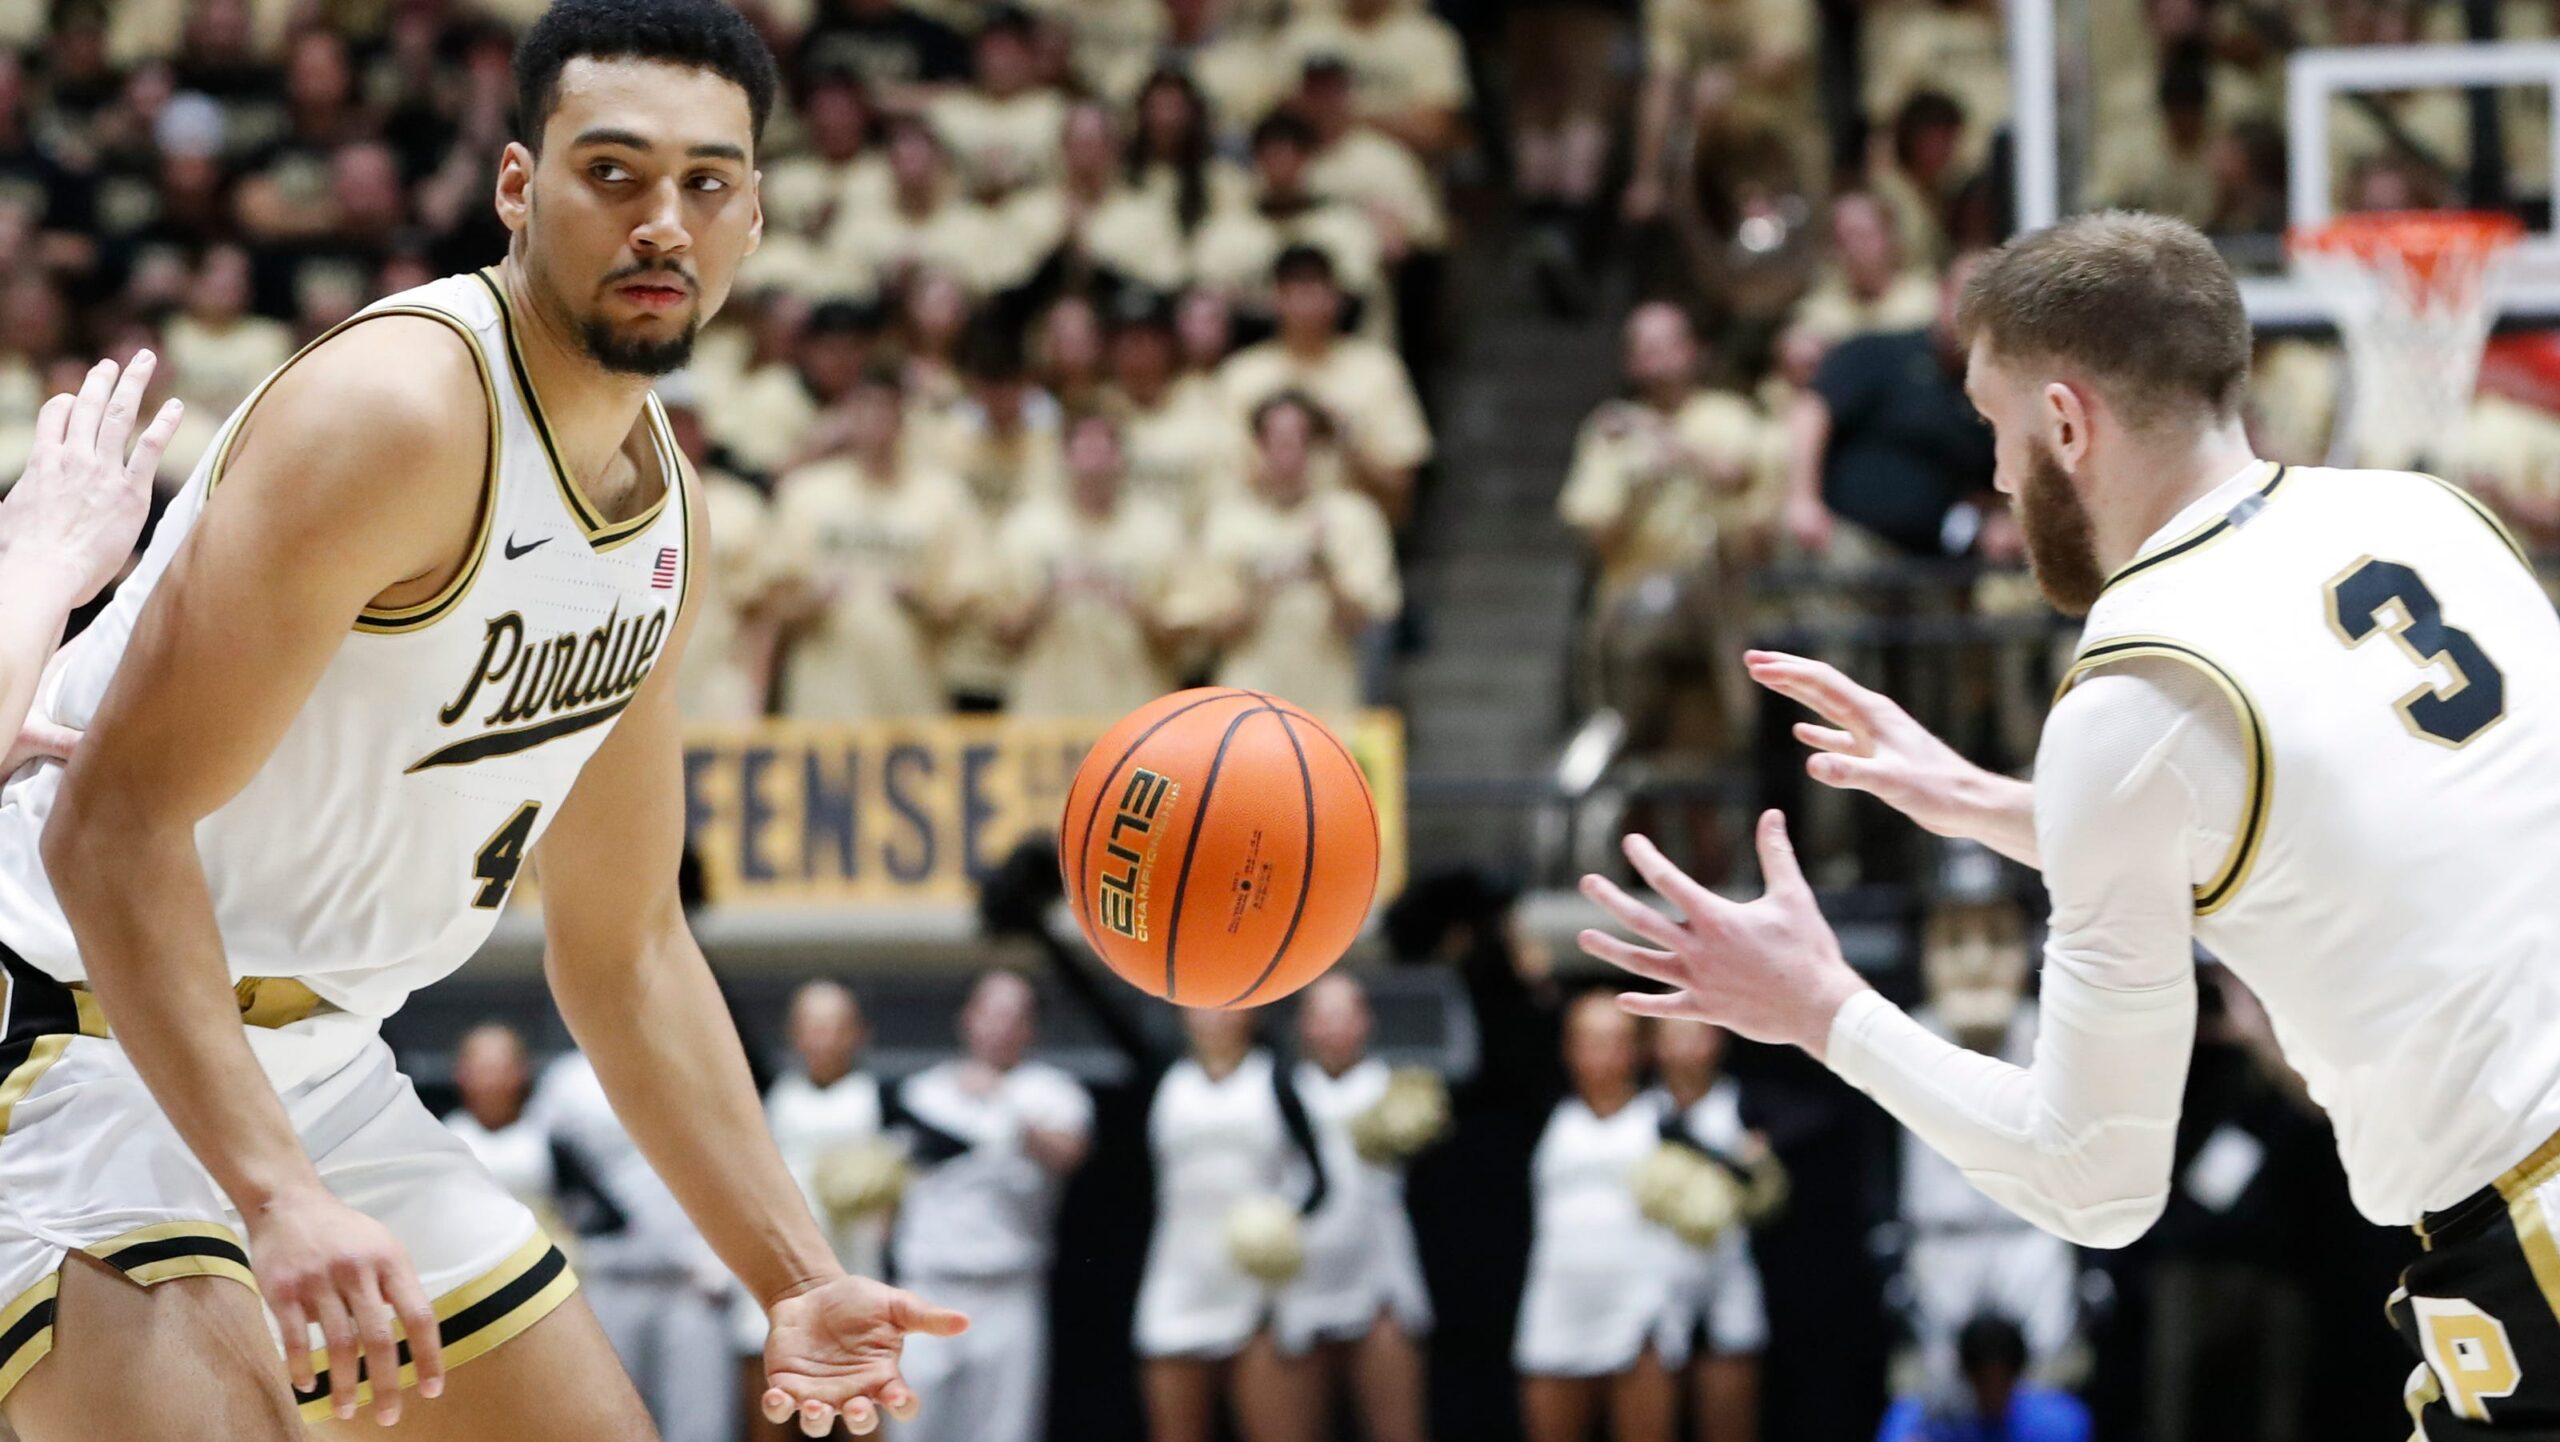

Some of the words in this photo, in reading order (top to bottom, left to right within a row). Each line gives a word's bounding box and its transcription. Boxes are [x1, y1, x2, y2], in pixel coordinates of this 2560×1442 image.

[438, 593, 667, 728] Purdue
[2322, 554, 2507, 750] 3
[470, 799, 542, 910] 4
[1099, 767, 1171, 941] ELITE
[2409, 1295, 2523, 1424] P
